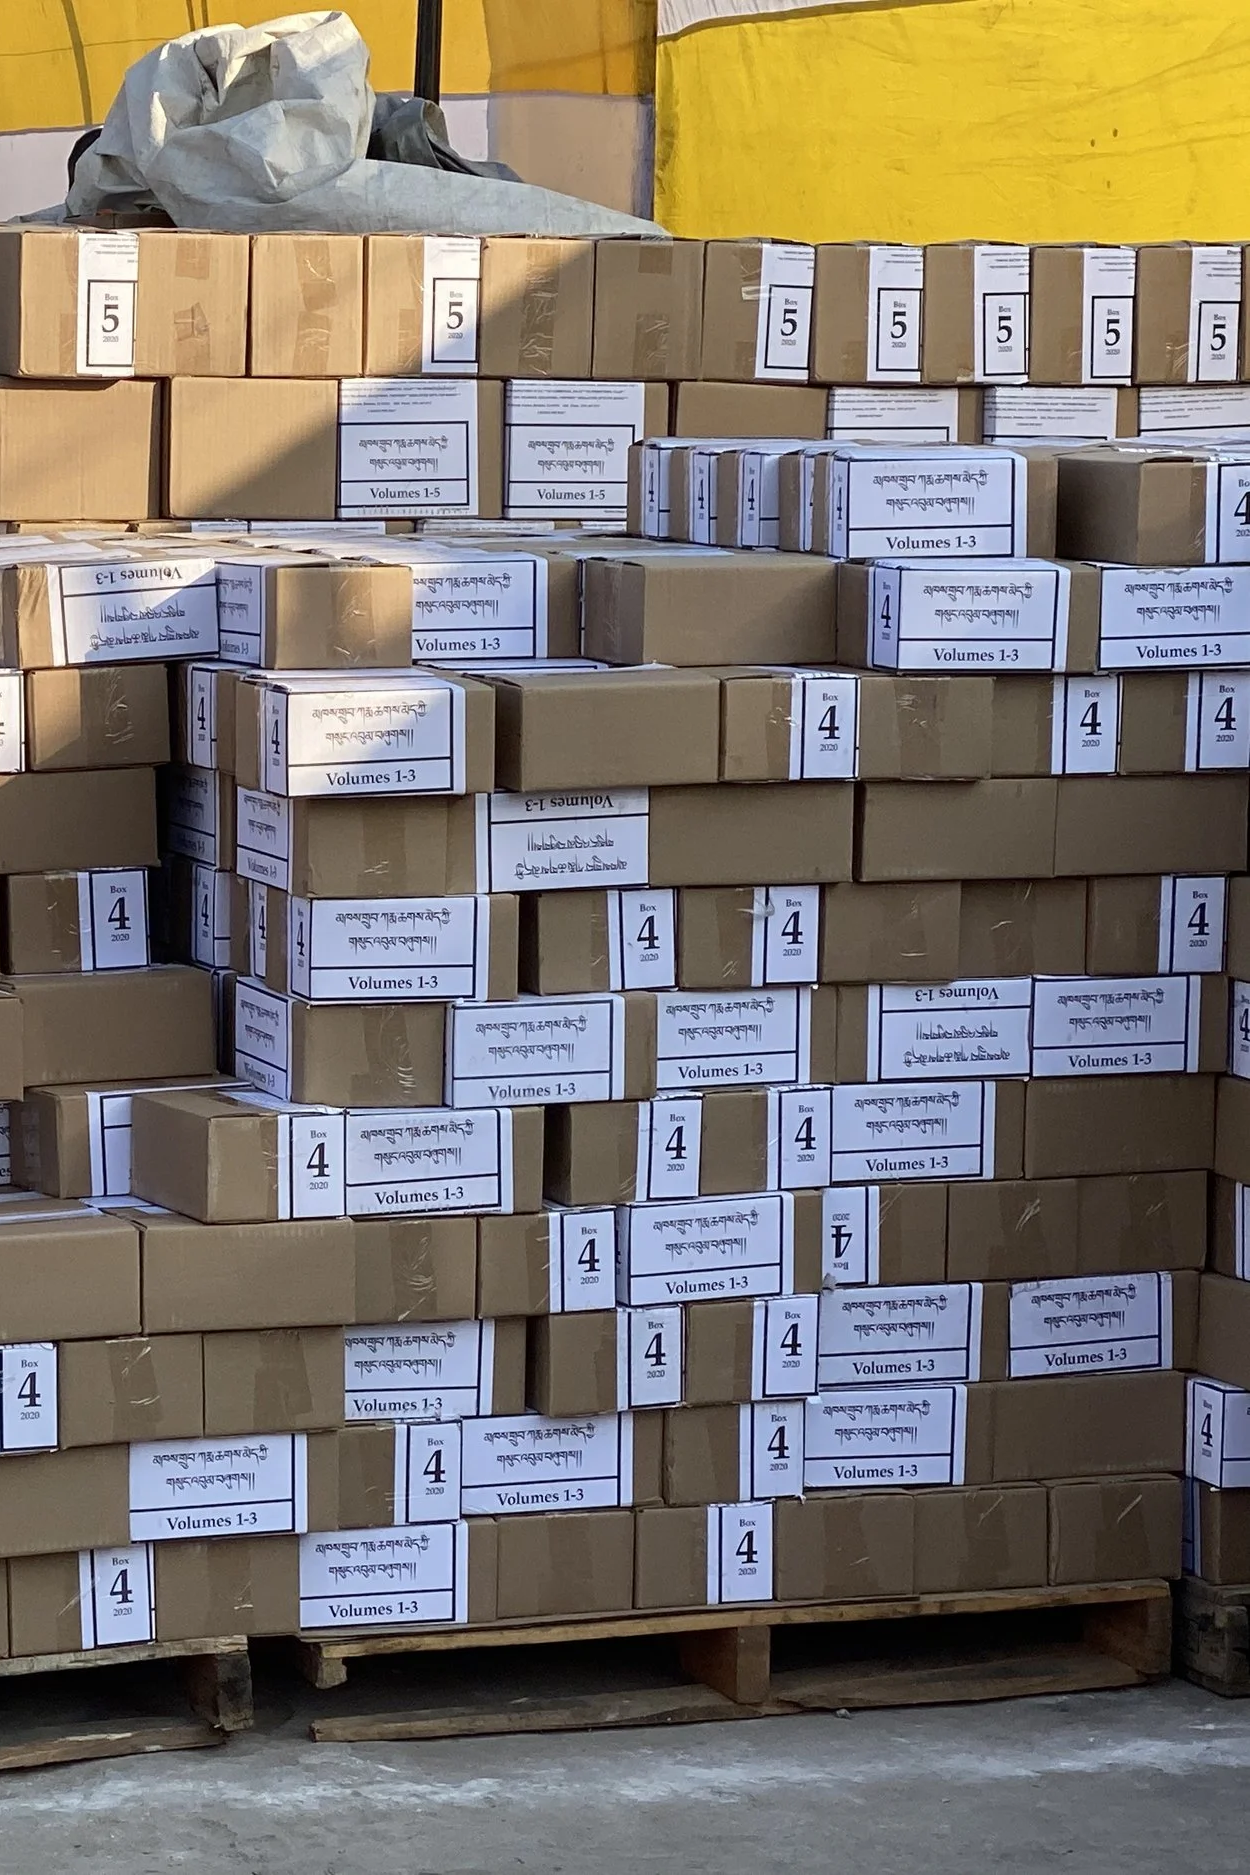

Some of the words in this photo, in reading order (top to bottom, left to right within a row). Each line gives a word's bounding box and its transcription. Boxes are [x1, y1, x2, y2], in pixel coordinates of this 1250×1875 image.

[102, 304, 119, 333] 5
[446, 301, 463, 330] 5
[780, 308, 797, 336] 5
[890, 311, 907, 339] 5
[996, 315, 1012, 343] 5
[1104, 318, 1120, 346] 5
[1210, 324, 1226, 351] 5
[370, 487, 420, 499] Volumes
[423, 487, 441, 498] 1-5
[537, 488, 586, 500] Volumes
[589, 489, 605, 500] 1-5
[886, 536, 951, 550] Volumes
[955, 535, 976, 548] 1-3
[95, 571, 116, 585] 1-3
[120, 567, 182, 581] Volumes
[880, 594, 892, 629] 4
[415, 638, 476, 652] Volumes
[481, 637, 500, 650] 1-3
[1136, 645, 1197, 659] Volumes
[1201, 643, 1222, 656] 1-3
[933, 648, 995, 662] Volumes
[999, 649, 1019, 662] 1-3
[197, 696, 206, 731] 4
[818, 705, 841, 740] 4
[1080, 701, 1103, 736] 4
[1214, 696, 1237, 731] 4
[271, 719, 281, 755] 4
[326, 772, 390, 786] Volumes
[395, 769, 416, 783] 1-3
[525, 799, 546, 812] 1-3
[550, 795, 614, 809] Volumes
[110, 885, 127, 894] Box
[108, 896, 132, 931] 4
[201, 893, 210, 928] 4
[1187, 902, 1210, 936] 4
[637, 915, 661, 950] 4
[781, 910, 804, 945] 4
[111, 933, 130, 942] 2020
[348, 976, 412, 990] Volumes
[418, 975, 438, 988] 1-3
[915, 989, 934, 1002] 1-3
[939, 987, 1000, 1001] Volumes
[1068, 1054, 1128, 1068] Volumes
[1132, 1052, 1152, 1065] 1-3
[678, 1065, 739, 1079] Volumes
[743, 1062, 763, 1076] 1-3
[488, 1085, 551, 1100] Volumes
[555, 1082, 576, 1096] 1-3
[665, 1125, 688, 1160] 4
[794, 1116, 817, 1151] 4
[306, 1142, 331, 1178] 4
[865, 1158, 925, 1172] Volumes
[929, 1156, 949, 1169] 1-3
[374, 1190, 439, 1205] Volumes
[443, 1186, 464, 1200] 1-3
[830, 1224, 853, 1259] 4
[578, 1238, 601, 1273] 4
[665, 1280, 725, 1294] Volumes
[729, 1276, 748, 1289] 1-3
[644, 1332, 667, 1367] 4
[780, 1323, 803, 1357] 4
[21, 1359, 39, 1368] Box
[852, 1361, 912, 1375] Volumes
[916, 1359, 935, 1372] 1-3
[1044, 1352, 1104, 1367] Volumes
[1107, 1348, 1127, 1361] 1-3
[17, 1372, 42, 1408] 4
[20, 1411, 40, 1420] 2020
[353, 1398, 417, 1415] Volumes
[422, 1397, 443, 1413] 1-3
[1201, 1413, 1213, 1448] 4
[767, 1425, 790, 1460] 4
[423, 1449, 447, 1484] 4
[833, 1465, 894, 1479] Volumes
[898, 1464, 918, 1477] 1-3
[496, 1492, 559, 1506] Volumes
[564, 1488, 584, 1502] 1-3
[166, 1516, 232, 1530] Volumes
[236, 1512, 257, 1526] 1-3
[735, 1530, 759, 1564] 4
[111, 1557, 130, 1566] Box
[109, 1568, 134, 1604] 4
[113, 1607, 133, 1617] 2020
[328, 1604, 393, 1618] Volumes
[398, 1600, 418, 1614] 1-3
